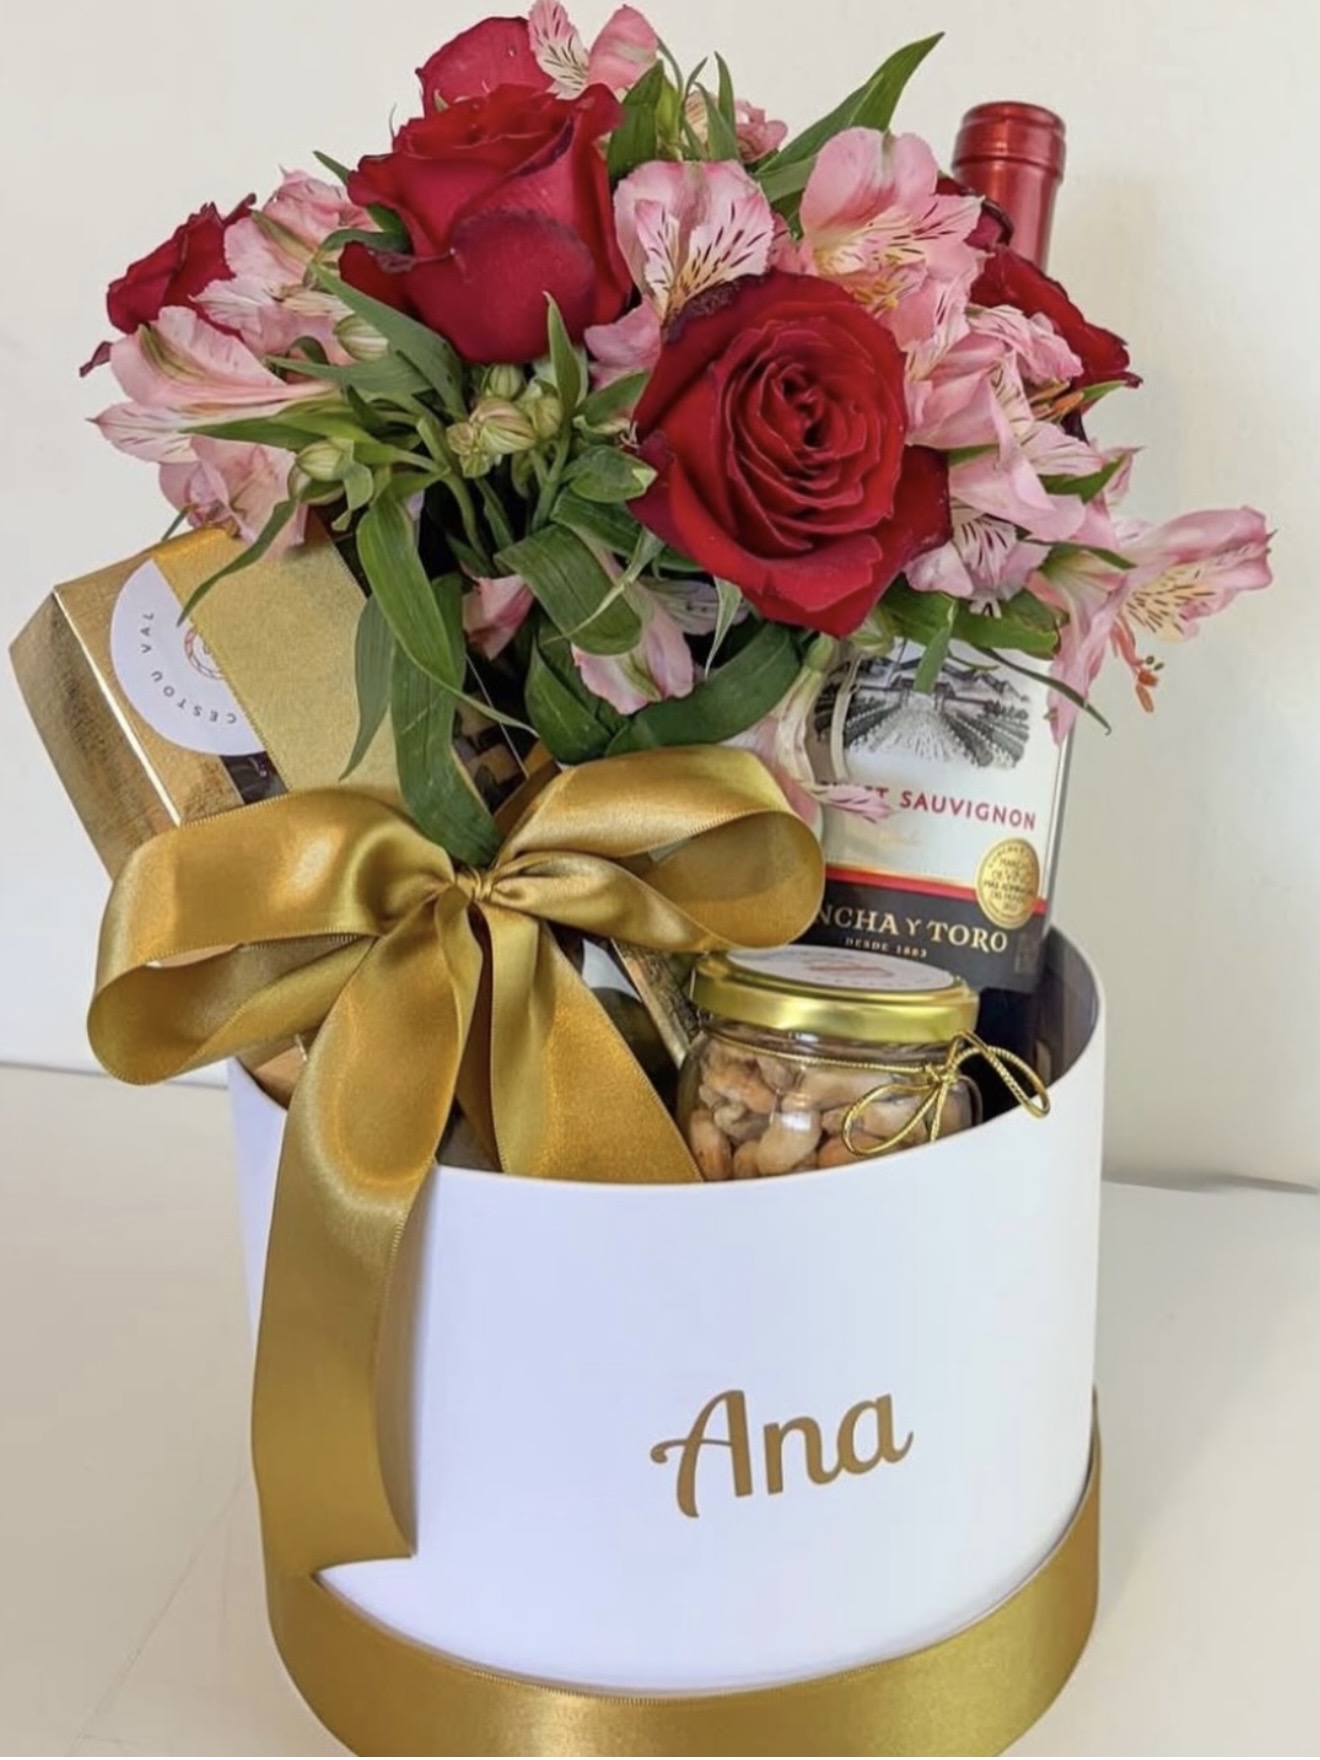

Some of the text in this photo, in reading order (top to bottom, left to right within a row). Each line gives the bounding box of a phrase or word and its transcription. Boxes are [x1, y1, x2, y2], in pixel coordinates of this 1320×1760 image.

[899, 789, 1037, 831] SAUVIGNON
[815, 904, 1008, 954] NCHA Y TORO
[845, 937, 890, 953] DESDE
[650, 1389, 915, 1518] Ana
